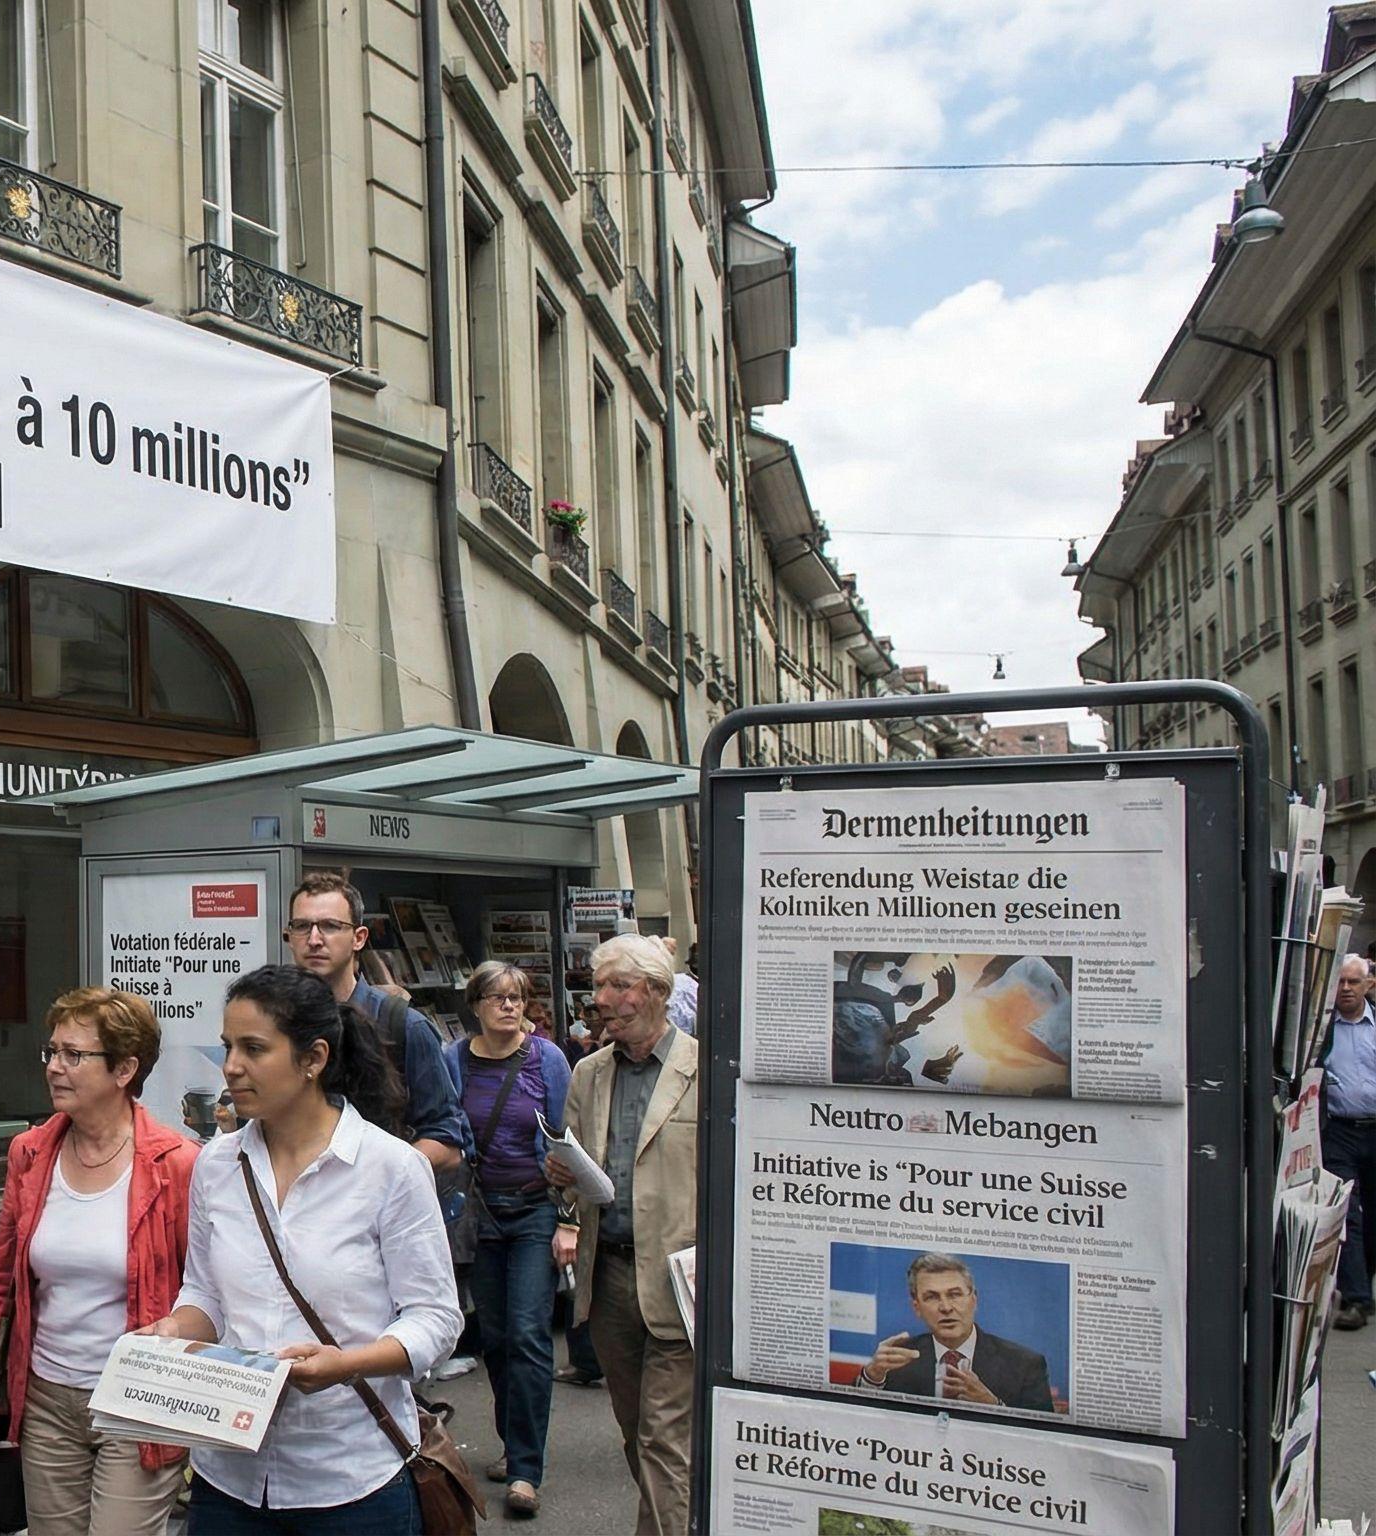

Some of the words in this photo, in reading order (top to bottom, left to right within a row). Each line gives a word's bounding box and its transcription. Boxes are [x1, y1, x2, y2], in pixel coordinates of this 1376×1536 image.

[16, 375, 44, 449] à
[61, 394, 116, 466] 10
[132, 421, 310, 512] millions”
[369, 814, 411, 840] NEWS
[822, 805, 1090, 844] Dermenheitungen
[760, 866, 915, 893] Referendung
[1027, 866, 1068, 890] die
[877, 895, 997, 919] Millionen
[1004, 897, 1121, 924] geseinen
[110, 933, 170, 951] Votation
[174, 932, 236, 951] fédérale
[110, 956, 161, 973] Initiate
[212, 960, 241, 973] une
[110, 977, 160, 996] Suisse
[163, 977, 172, 996] à
[809, 1102, 904, 1132] Neutro
[944, 1110, 1098, 1149] Mebangen
[753, 1151, 861, 1180] Initiative
[868, 1159, 888, 1182] is
[895, 1160, 973, 1188] “Pour
[980, 1172, 1033, 1193] une
[1040, 1171, 1127, 1200] Suisse
[752, 1182, 776, 1202] et
[782, 1181, 891, 1211] Réforme
[899, 1190, 934, 1214] du
[942, 1198, 1039, 1223] service
[1046, 1202, 1105, 1229] civil
[736, 1420, 850, 1457] Initiative
[856, 1436, 933, 1468] “Pour
[939, 1447, 954, 1473] à
[962, 1453, 1047, 1487] Suisse
[735, 1452, 759, 1472] et
[766, 1453, 877, 1490] Réforme
[884, 1470, 919, 1497] du
[926, 1482, 1022, 1514] service
[1029, 1495, 1087, 1525] civil
